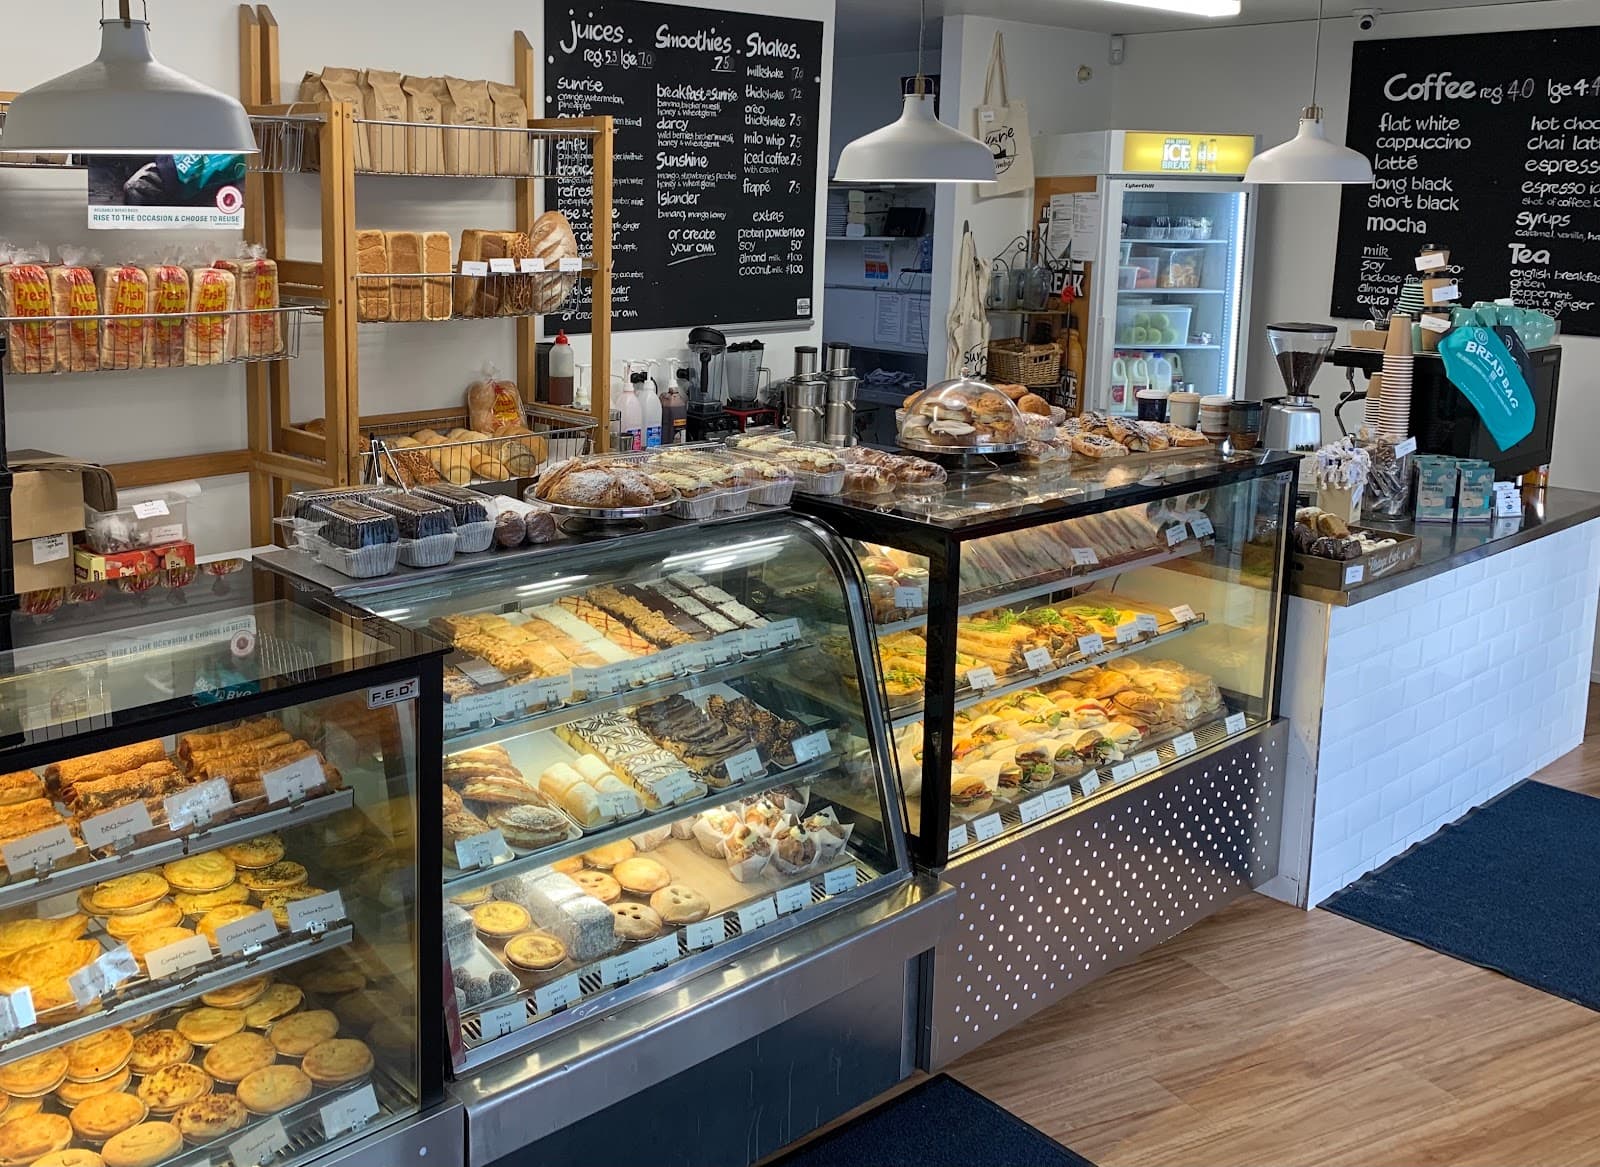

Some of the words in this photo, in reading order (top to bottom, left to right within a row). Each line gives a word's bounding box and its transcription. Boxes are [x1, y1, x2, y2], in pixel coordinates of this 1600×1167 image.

[746, 32, 800, 60] Shakes.
[746, 64, 784, 79] milkshake
[656, 83, 706, 101] breakfast
[1383, 72, 1477, 101] Coffee
[656, 116, 689, 131] darcy
[1378, 112, 1411, 132] flat
[1415, 114, 1461, 131] white
[1530, 116, 1560, 130] hot
[744, 131, 764, 145] milo
[766, 133, 785, 149] whip
[1376, 133, 1472, 151] cappuccino
[1527, 134, 1566, 150] chai
[743, 148, 764, 165] iced
[765, 152, 790, 165] coffee
[1163, 143, 1192, 161] ICE
[1161, 160, 1191, 170] BREAK
[1525, 159, 1600, 175] espress
[1372, 174, 1408, 194] long
[1411, 176, 1454, 192] black
[1521, 181, 1586, 198] espresso
[1417, 194, 1460, 211] black
[1557, 197, 1592, 207] coffee
[136, 214, 173, 222] OCCASION
[752, 209, 784, 222] extras
[1366, 216, 1427, 234] mocha
[668, 229, 681, 240] or
[682, 228, 716, 240] create
[670, 242, 695, 257] your
[695, 243, 714, 253] own
[739, 241, 756, 252] soy
[1363, 243, 1389, 257] milk
[1508, 243, 1550, 264] Tea
[739, 252, 766, 264] almond
[739, 264, 771, 275] coconut
[1509, 268, 1551, 281] english
[1360, 272, 1401, 283] lactose
[1509, 278, 1546, 289] green
[1357, 283, 1398, 295] almond
[1509, 289, 1573, 300] peppermint
[1356, 294, 1390, 306] extra
[1554, 299, 1595, 312] ginger
[1464, 340, 1504, 378] BREAD
[1502, 377, 1519, 409] BAG
